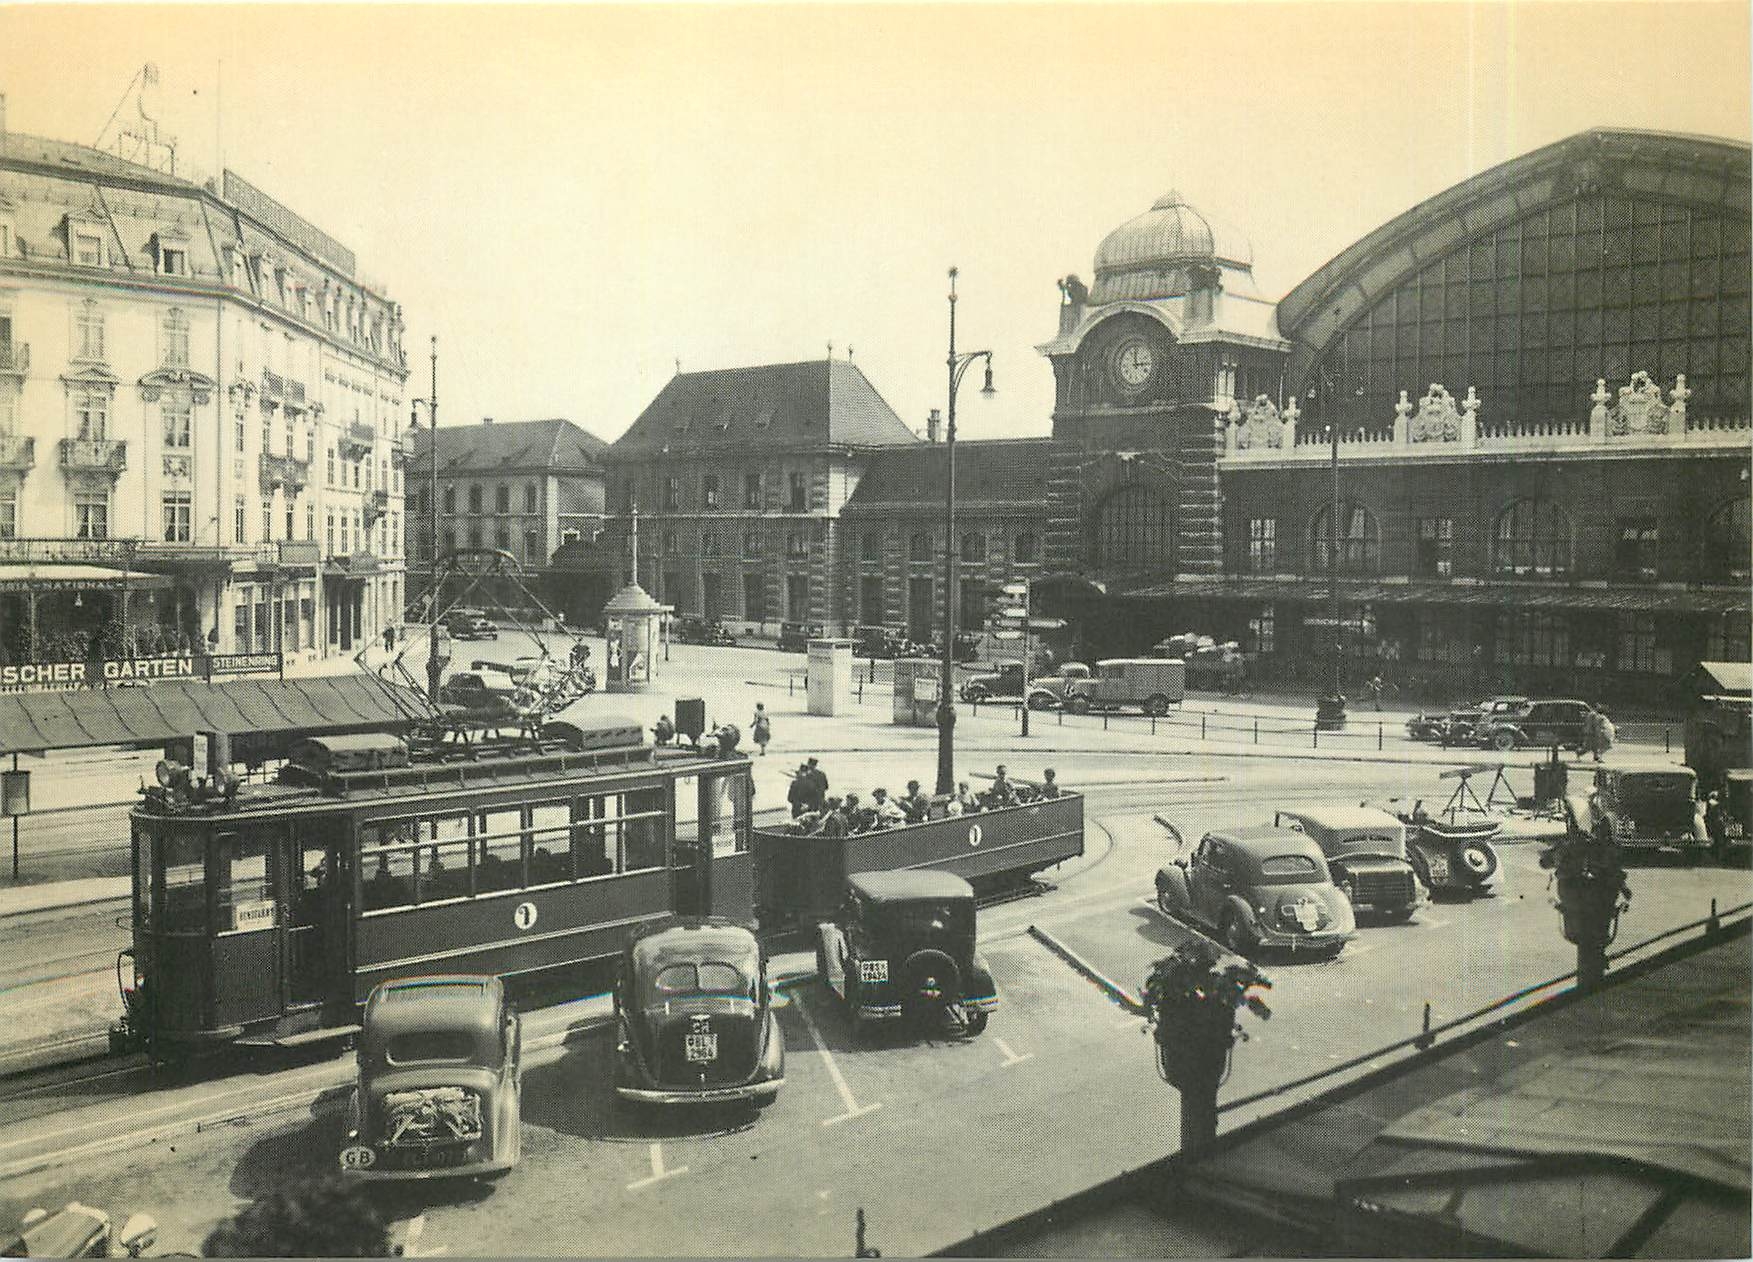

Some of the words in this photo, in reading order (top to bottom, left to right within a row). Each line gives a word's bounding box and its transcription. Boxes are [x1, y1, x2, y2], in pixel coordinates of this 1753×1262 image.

[0, 663, 85, 684] SCHER
[104, 659, 192, 678] GARTEN
[345, 1151, 370, 1165] GB
